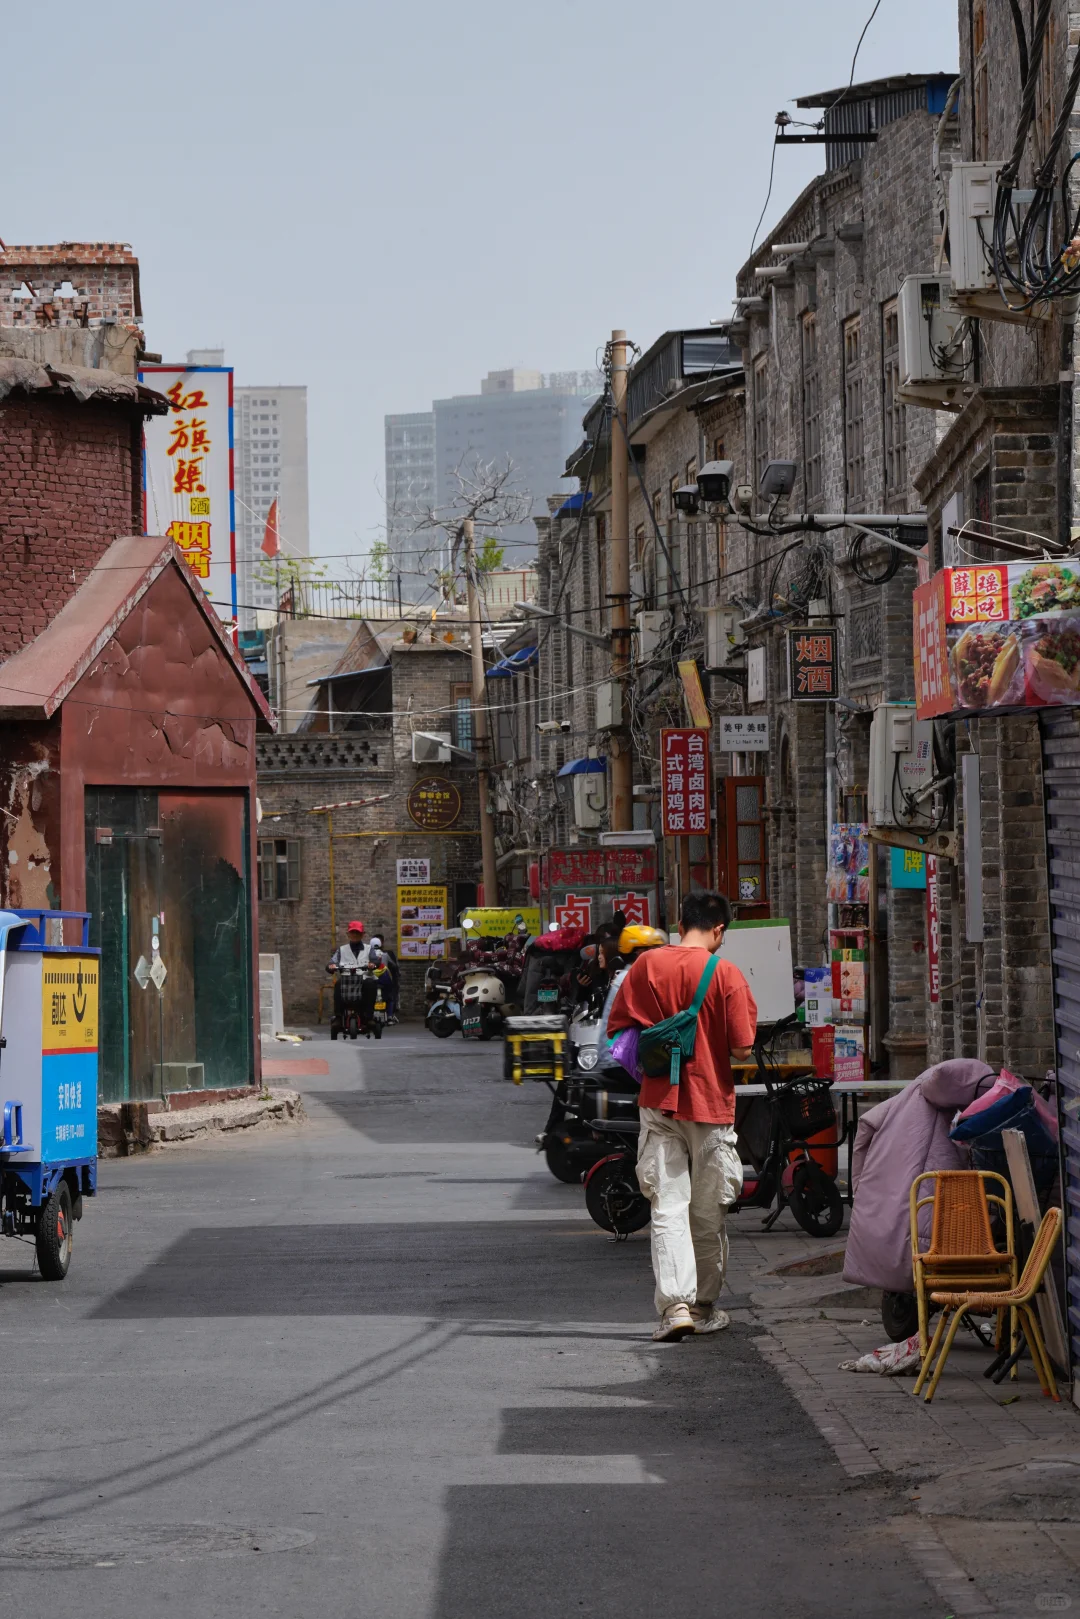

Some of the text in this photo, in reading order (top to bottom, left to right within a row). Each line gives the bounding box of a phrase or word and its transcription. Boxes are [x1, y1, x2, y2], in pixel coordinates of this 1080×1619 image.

[167, 381, 210, 493] 红旗渠
[953, 572, 999, 594] 薛瑶
[952, 598, 1002, 618] 小吃
[796, 635, 832, 692] 烟酒
[724, 723, 743, 732] 美甲
[666, 734, 684, 830] 广式滑鸡饭
[687, 734, 706, 829] 台湾卤肉饭
[554, 891, 650, 935] 卤肉
[52, 992, 67, 1025] 韵达
[58, 1081, 82, 1110] 安阳快递
